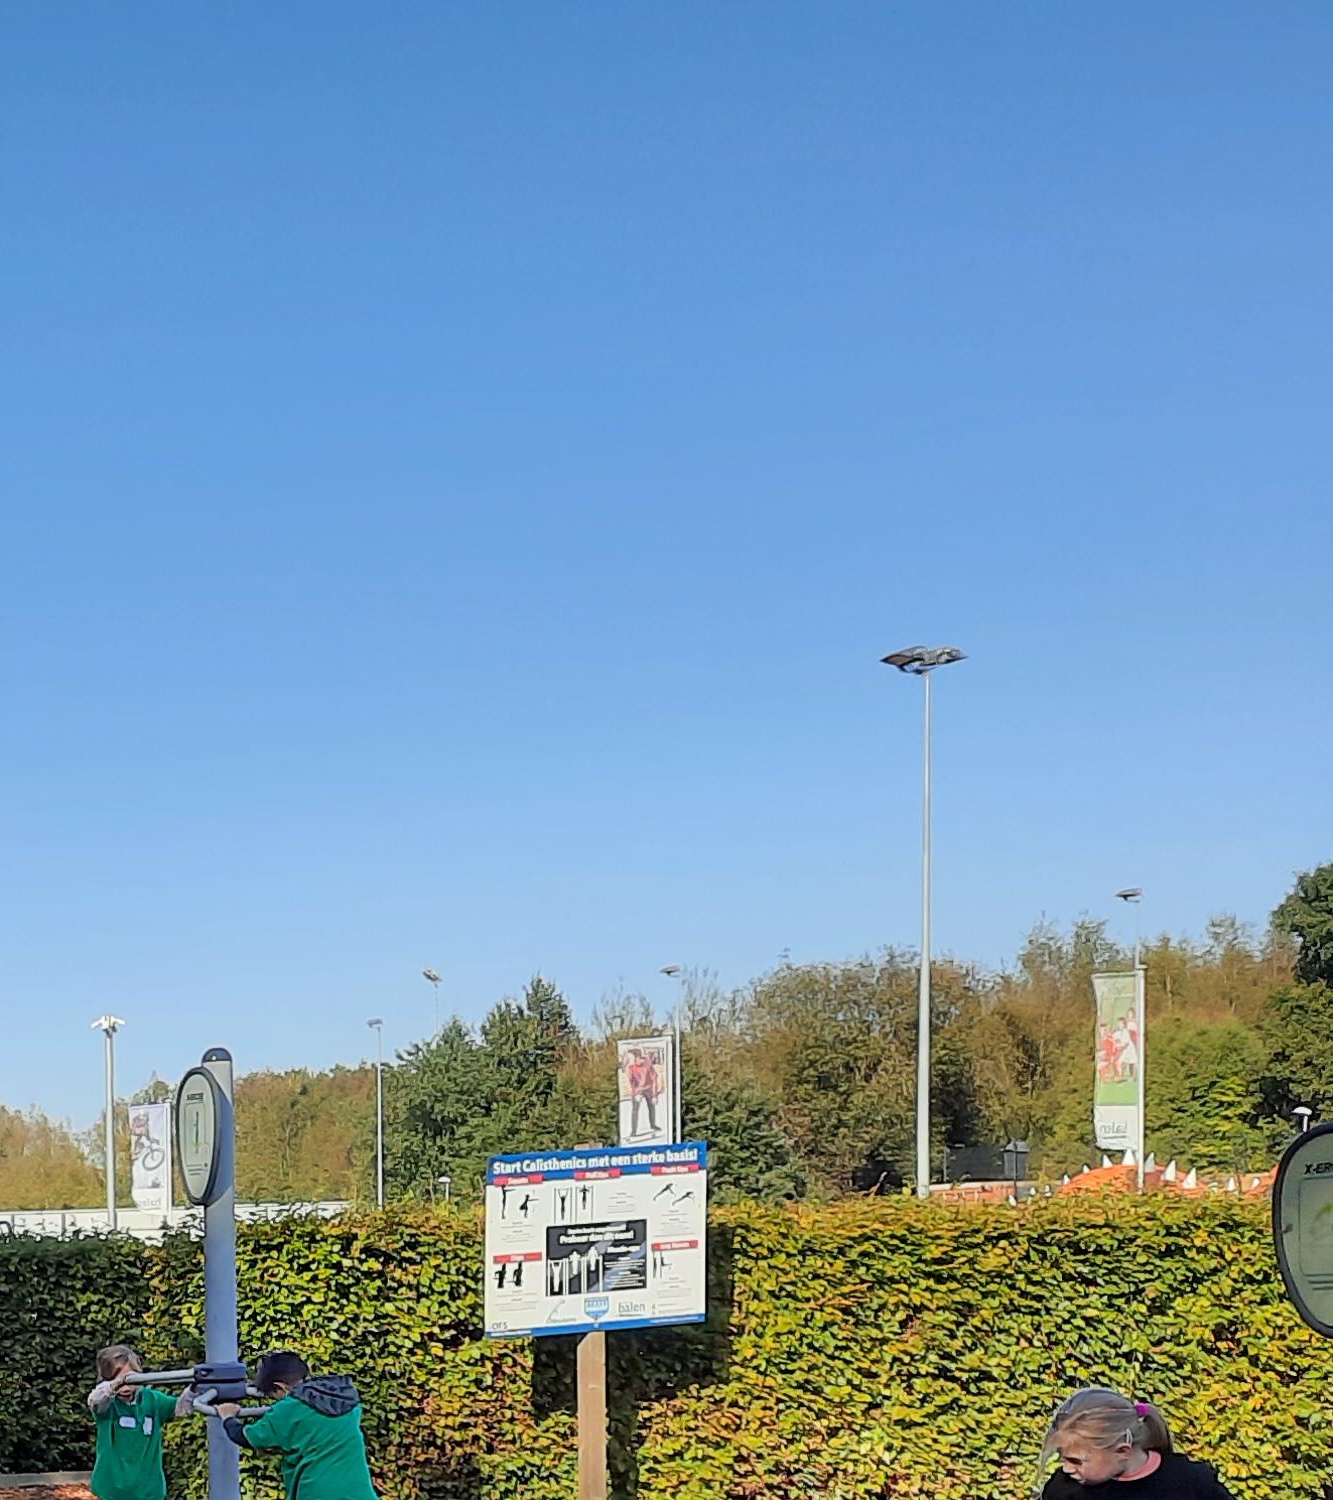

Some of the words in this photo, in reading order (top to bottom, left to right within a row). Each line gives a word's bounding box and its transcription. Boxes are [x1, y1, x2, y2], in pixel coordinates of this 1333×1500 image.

[493, 1161, 522, 1175] Start
[522, 1156, 587, 1172] Calisthenics
[587, 1154, 610, 1168] met
[610, 1155, 631, 1167] een
[631, 1149, 666, 1164] sterke
[666, 1147, 698, 1162] basis!
[618, 1301, 646, 1313] balen
